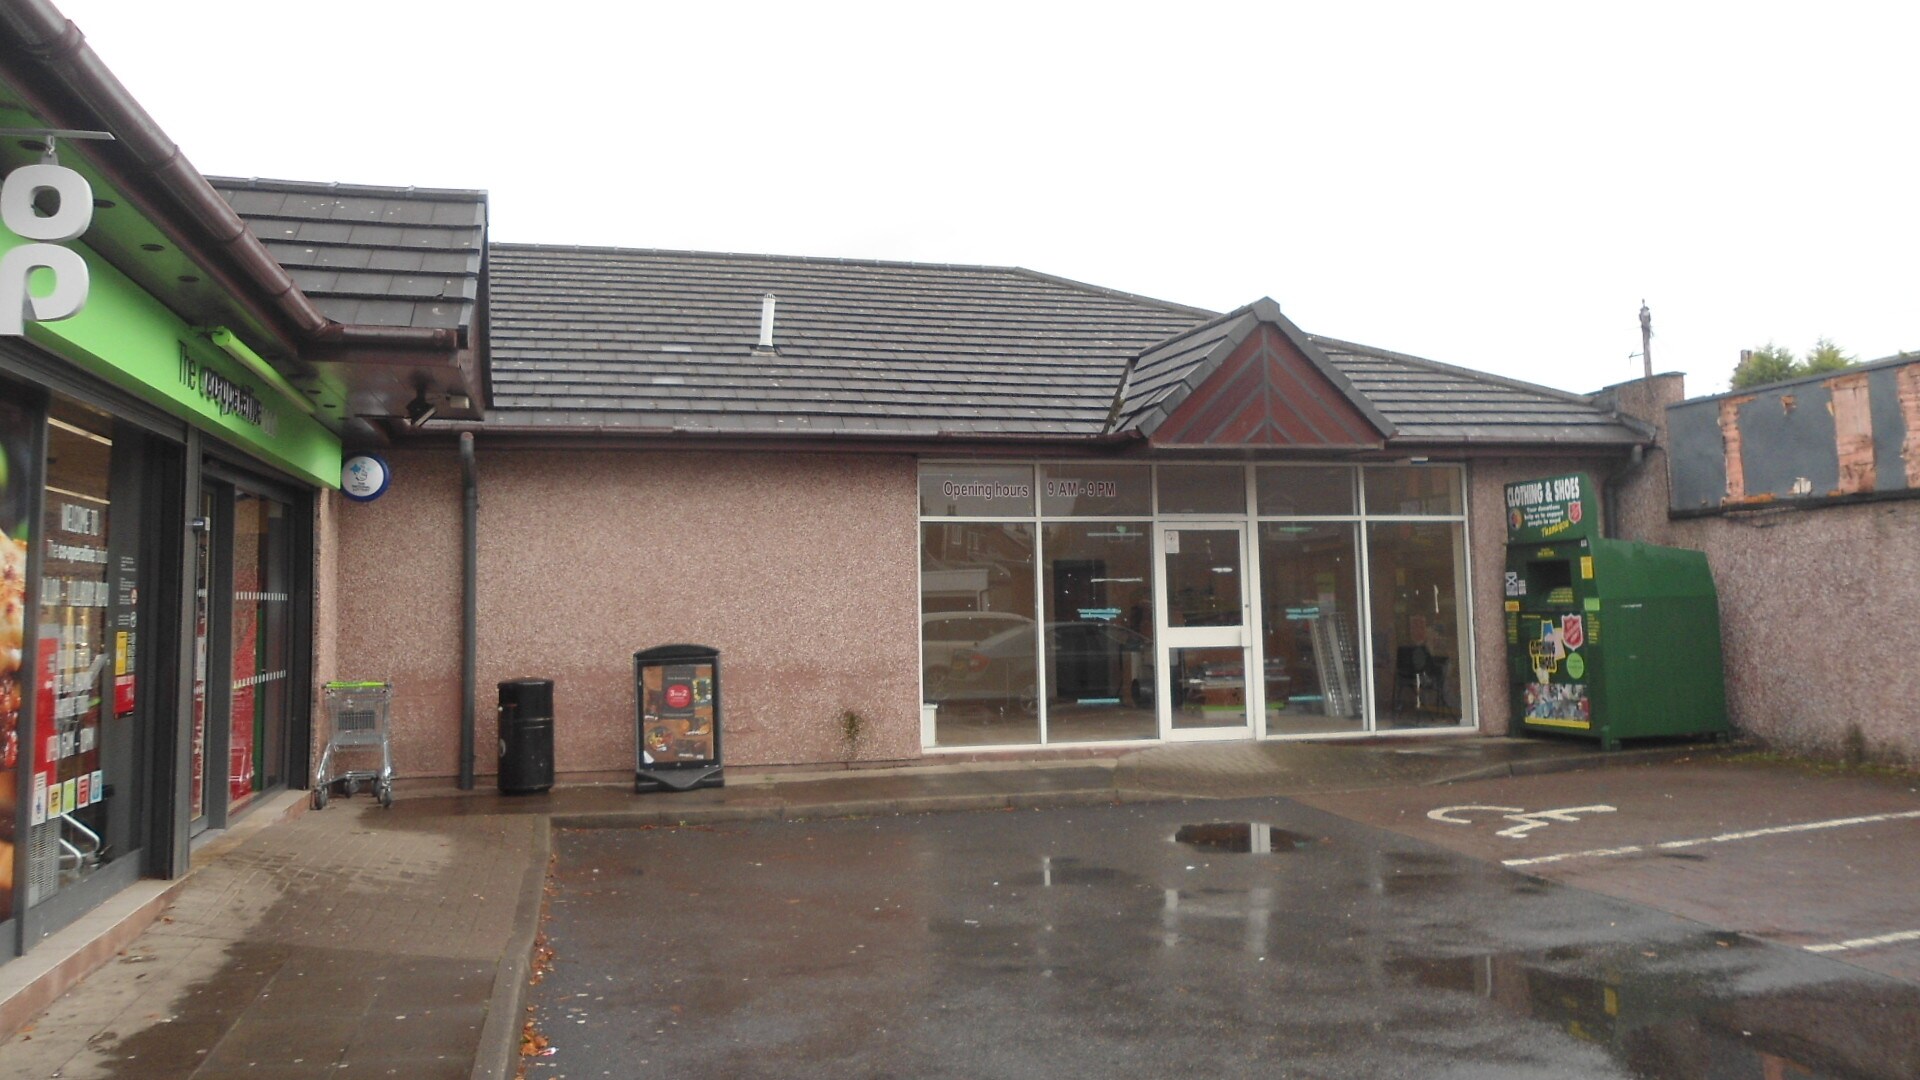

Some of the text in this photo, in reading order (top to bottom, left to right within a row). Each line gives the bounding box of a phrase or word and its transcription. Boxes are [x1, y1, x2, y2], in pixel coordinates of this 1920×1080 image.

[944, 481, 992, 500] Opening
[995, 481, 1029, 497] hours
[1047, 481, 1055, 496] 9
[1058, 482, 1077, 496] AM
[1087, 481, 1095, 497] 9
[1098, 482, 1116, 497] PM
[1507, 476, 1580, 507] CLOTHING & SHOES
